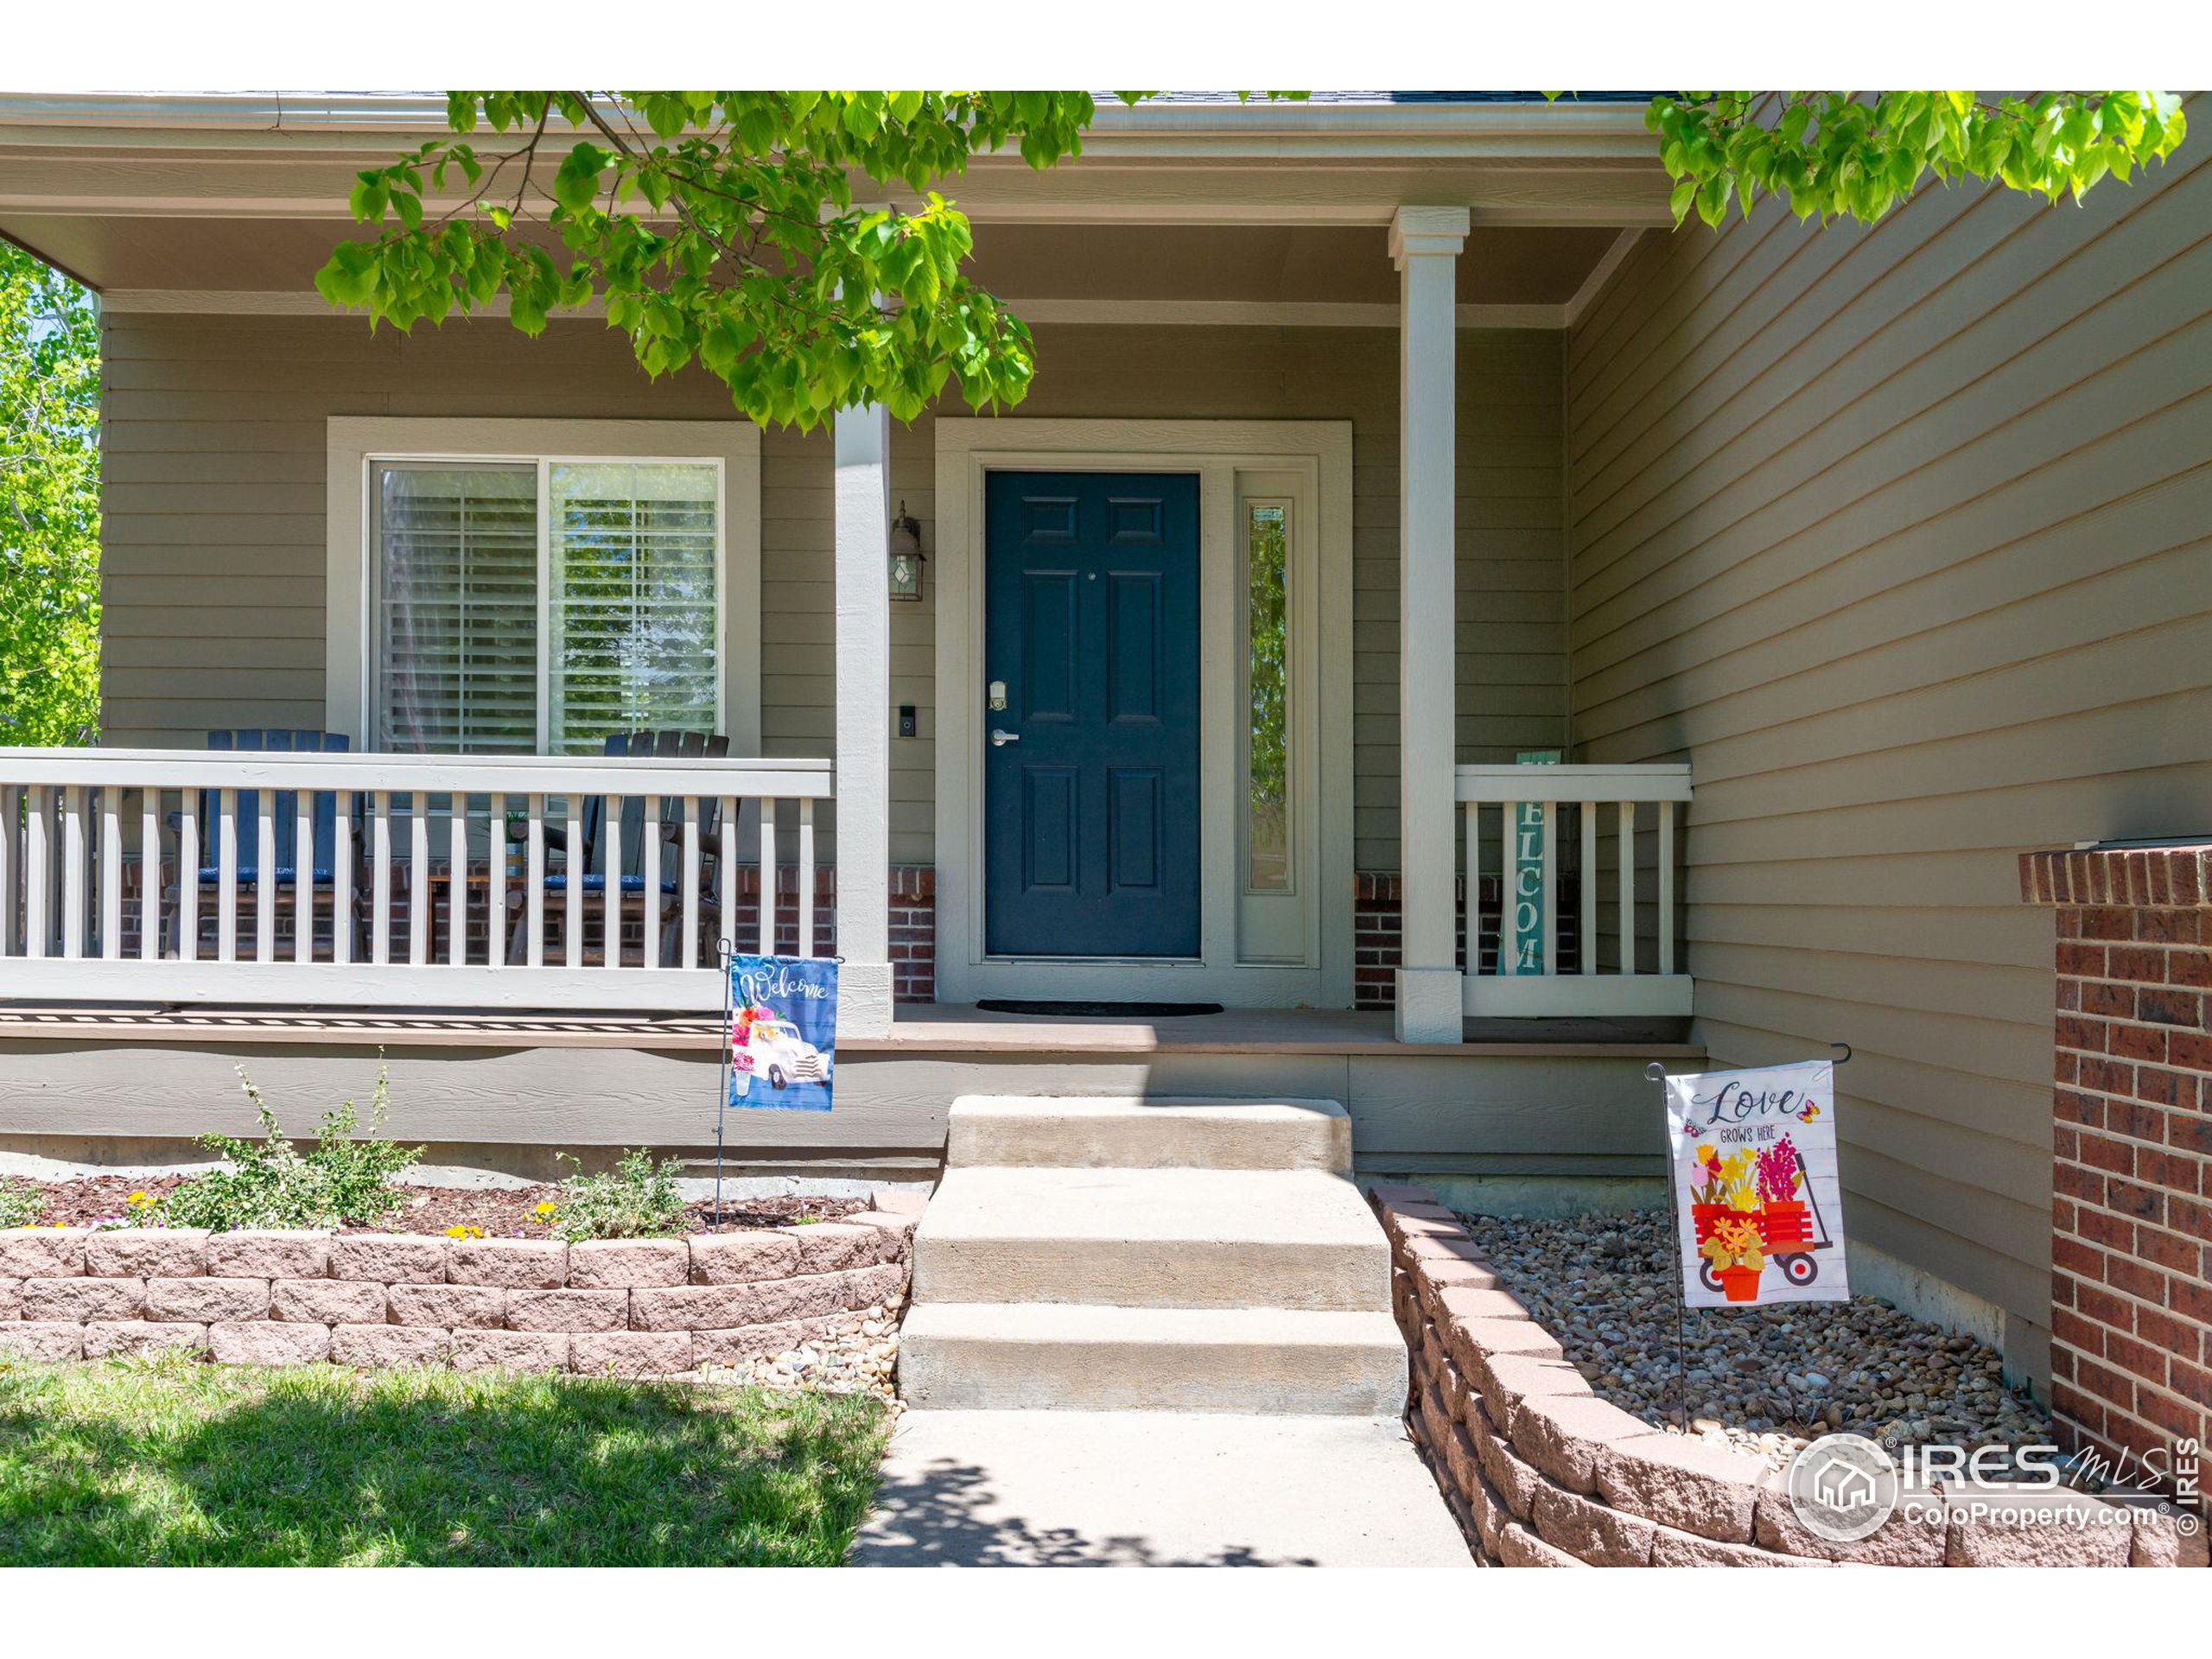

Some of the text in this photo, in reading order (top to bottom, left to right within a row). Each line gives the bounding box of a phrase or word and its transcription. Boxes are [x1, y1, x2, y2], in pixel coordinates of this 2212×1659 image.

[740, 963, 830, 1003] Welcome
[1692, 1082, 1804, 1125] Love
[1720, 1125, 1776, 1143] GROWS HERE
